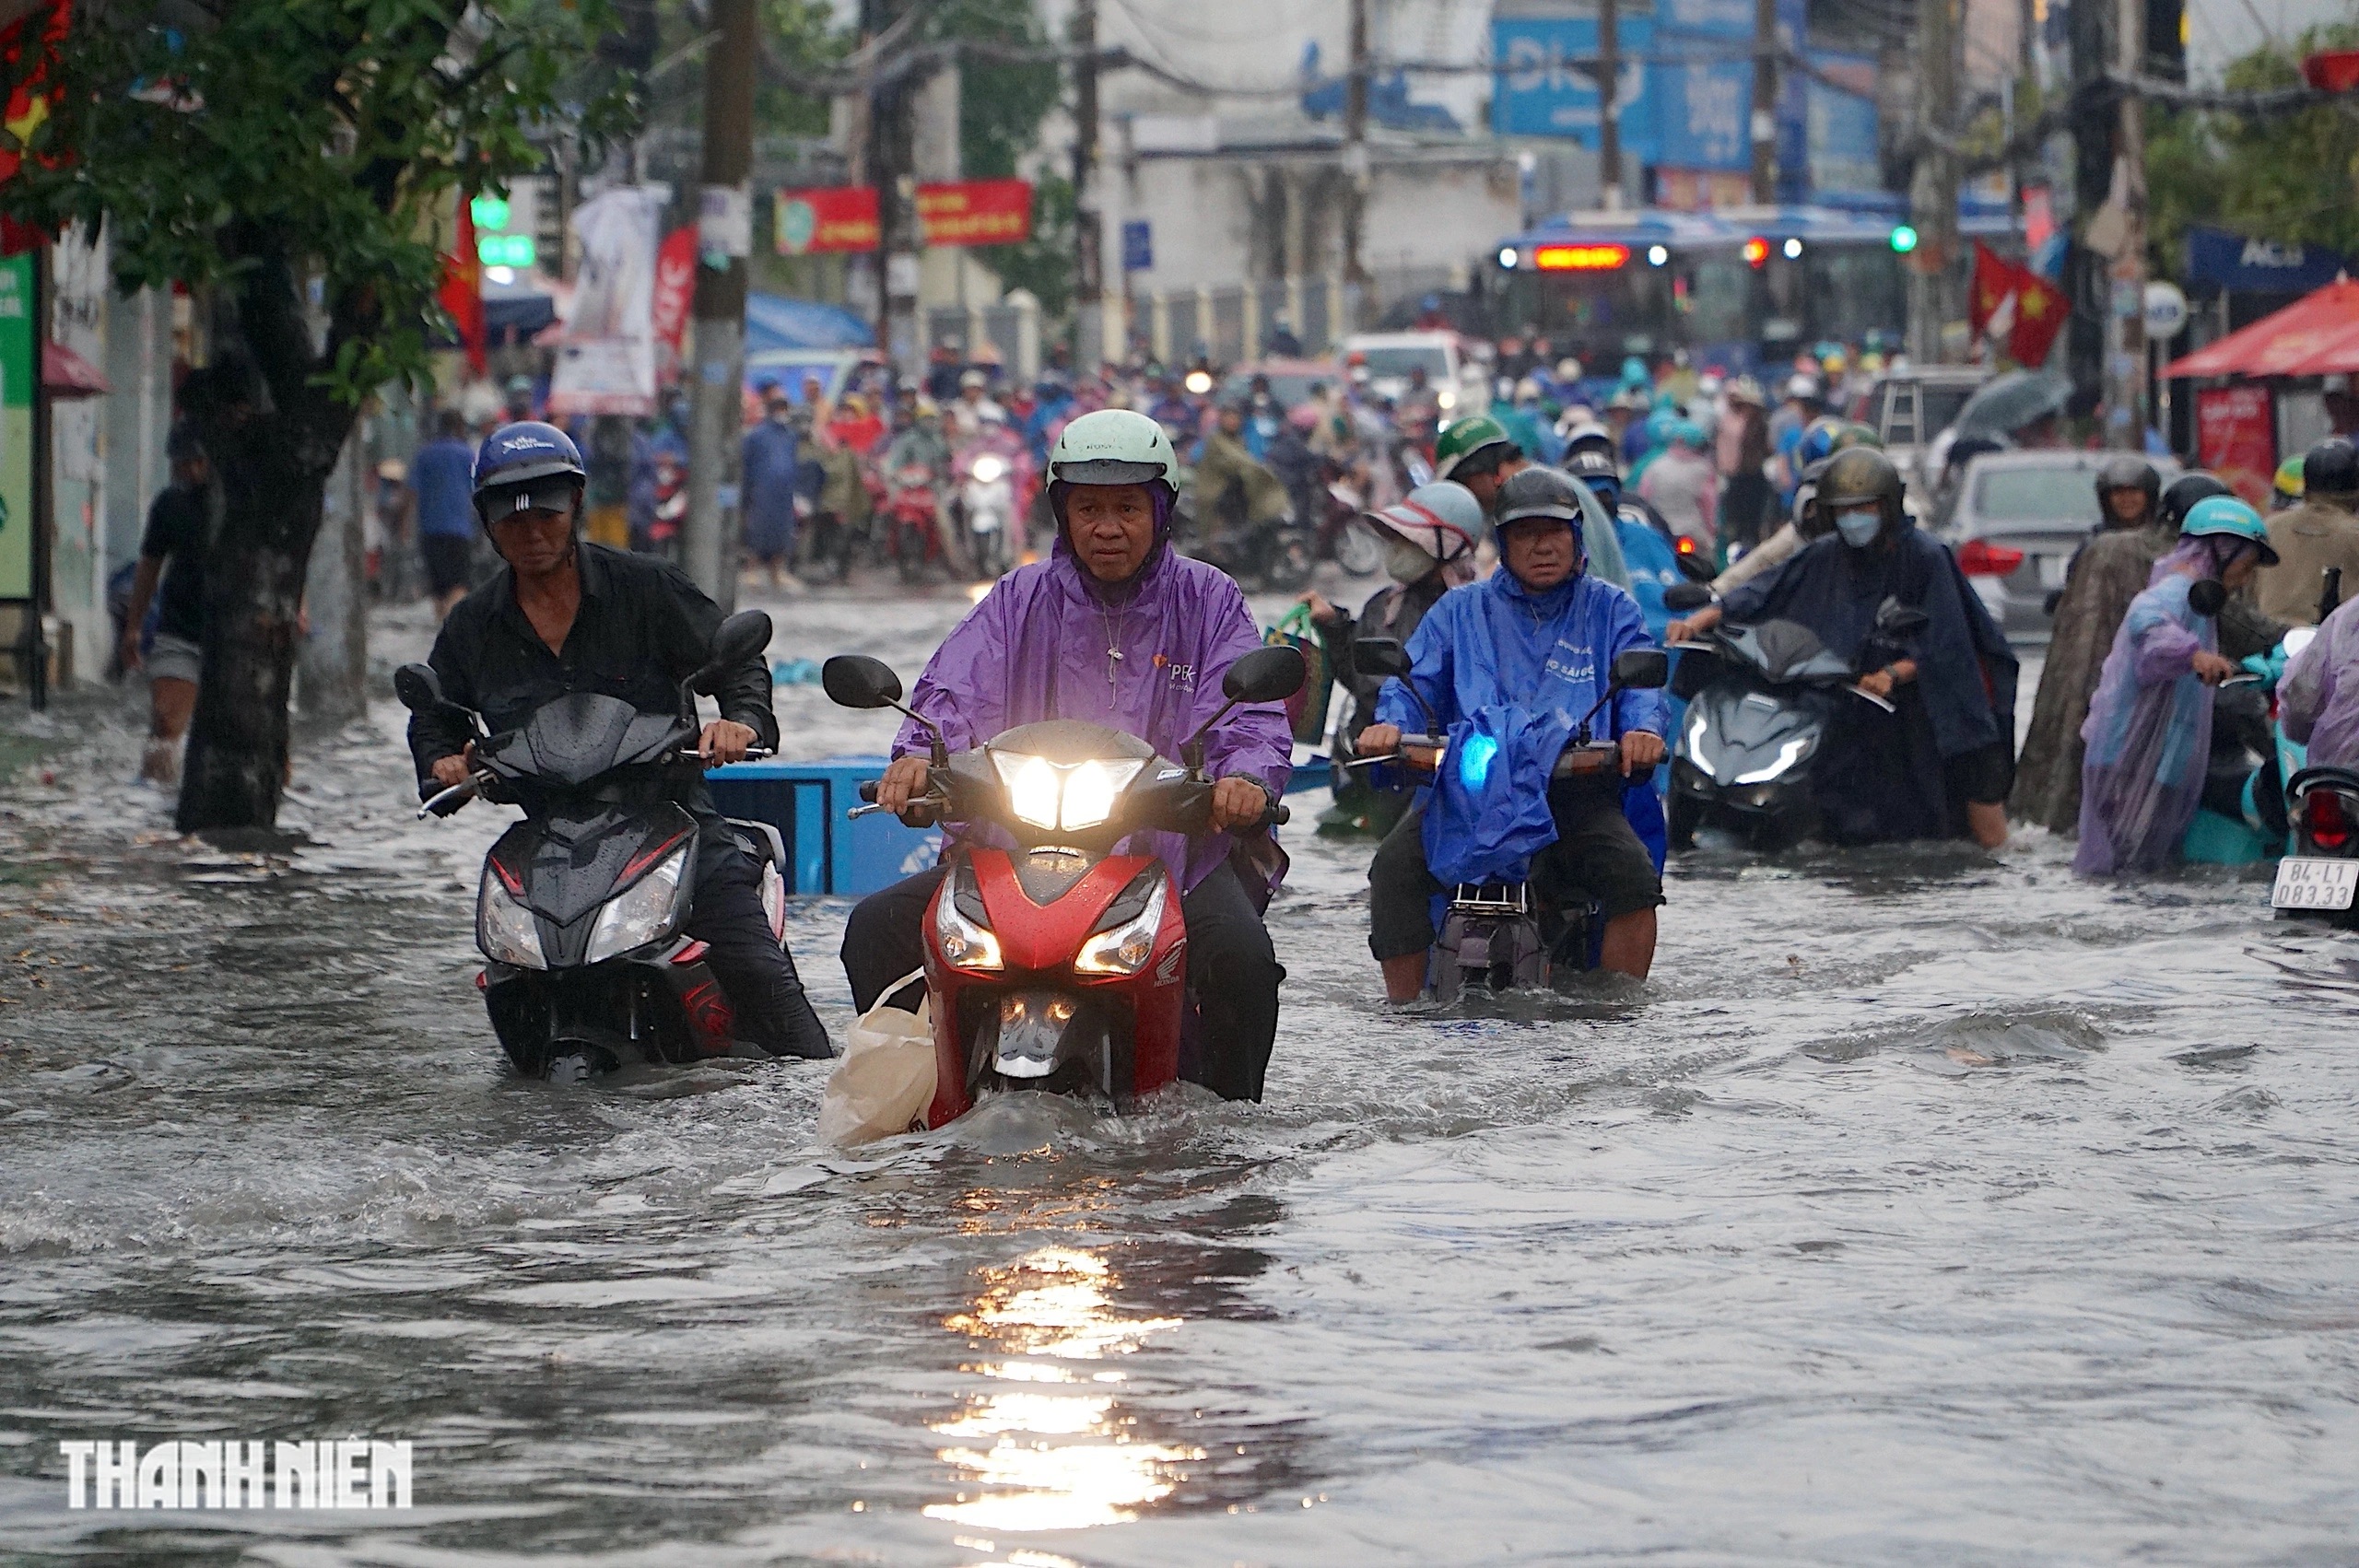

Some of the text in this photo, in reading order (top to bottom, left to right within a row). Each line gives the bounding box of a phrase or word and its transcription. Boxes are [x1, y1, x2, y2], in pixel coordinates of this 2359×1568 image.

[1029, 845, 1080, 857] HONDA
[2278, 884, 2349, 906] 083.33
[1154, 976, 1180, 988] HONDA
